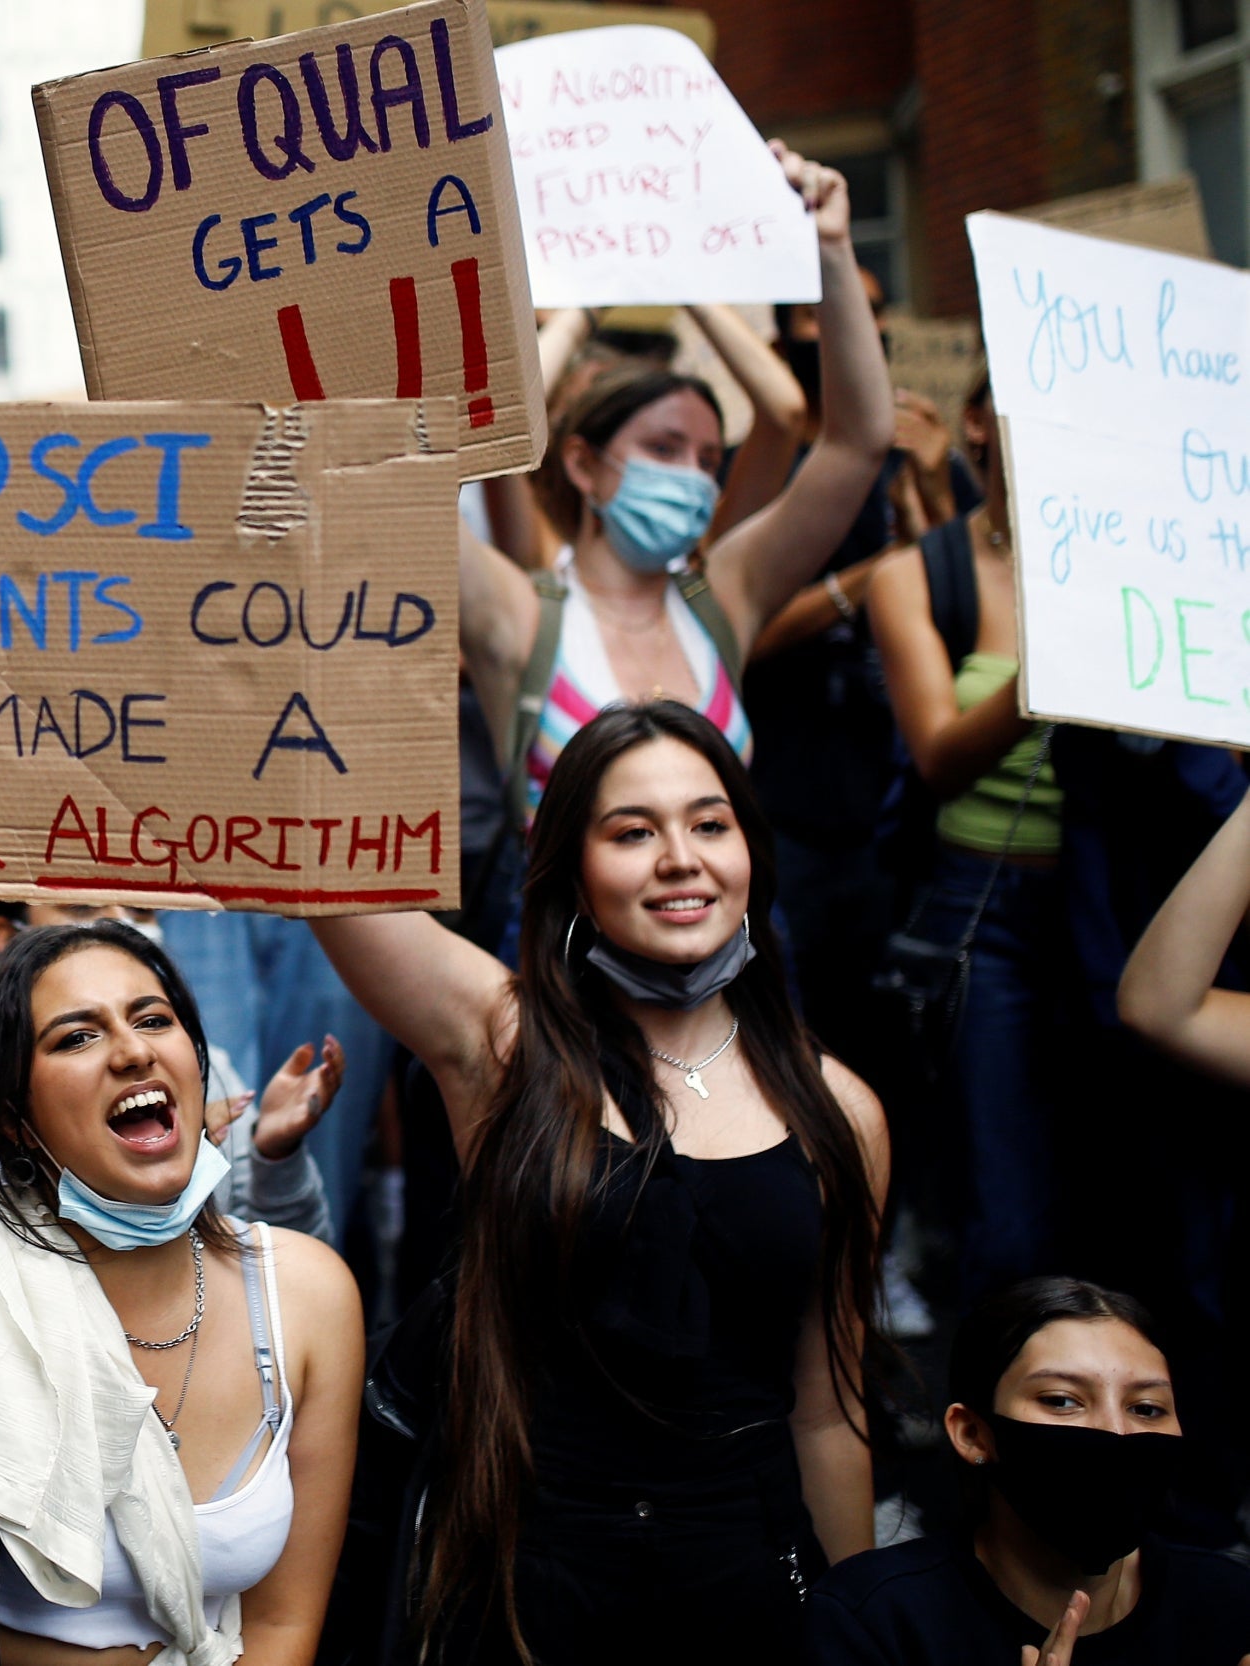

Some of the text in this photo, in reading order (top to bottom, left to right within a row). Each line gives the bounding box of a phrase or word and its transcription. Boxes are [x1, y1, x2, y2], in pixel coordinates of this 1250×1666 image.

[514, 120, 713, 158] CIDED MY
[192, 175, 482, 291] GETS A
[534, 160, 703, 216] FUTURE!
[536, 214, 780, 262] PISSED OFF
[1157, 278, 1241, 385] have
[1040, 495, 1127, 586] give
[1149, 516, 1187, 563] us
[190, 578, 437, 651] COULD
[1121, 585, 1250, 713] DE
[252, 691, 350, 781] A
[44, 793, 443, 884] ALGORITHM
